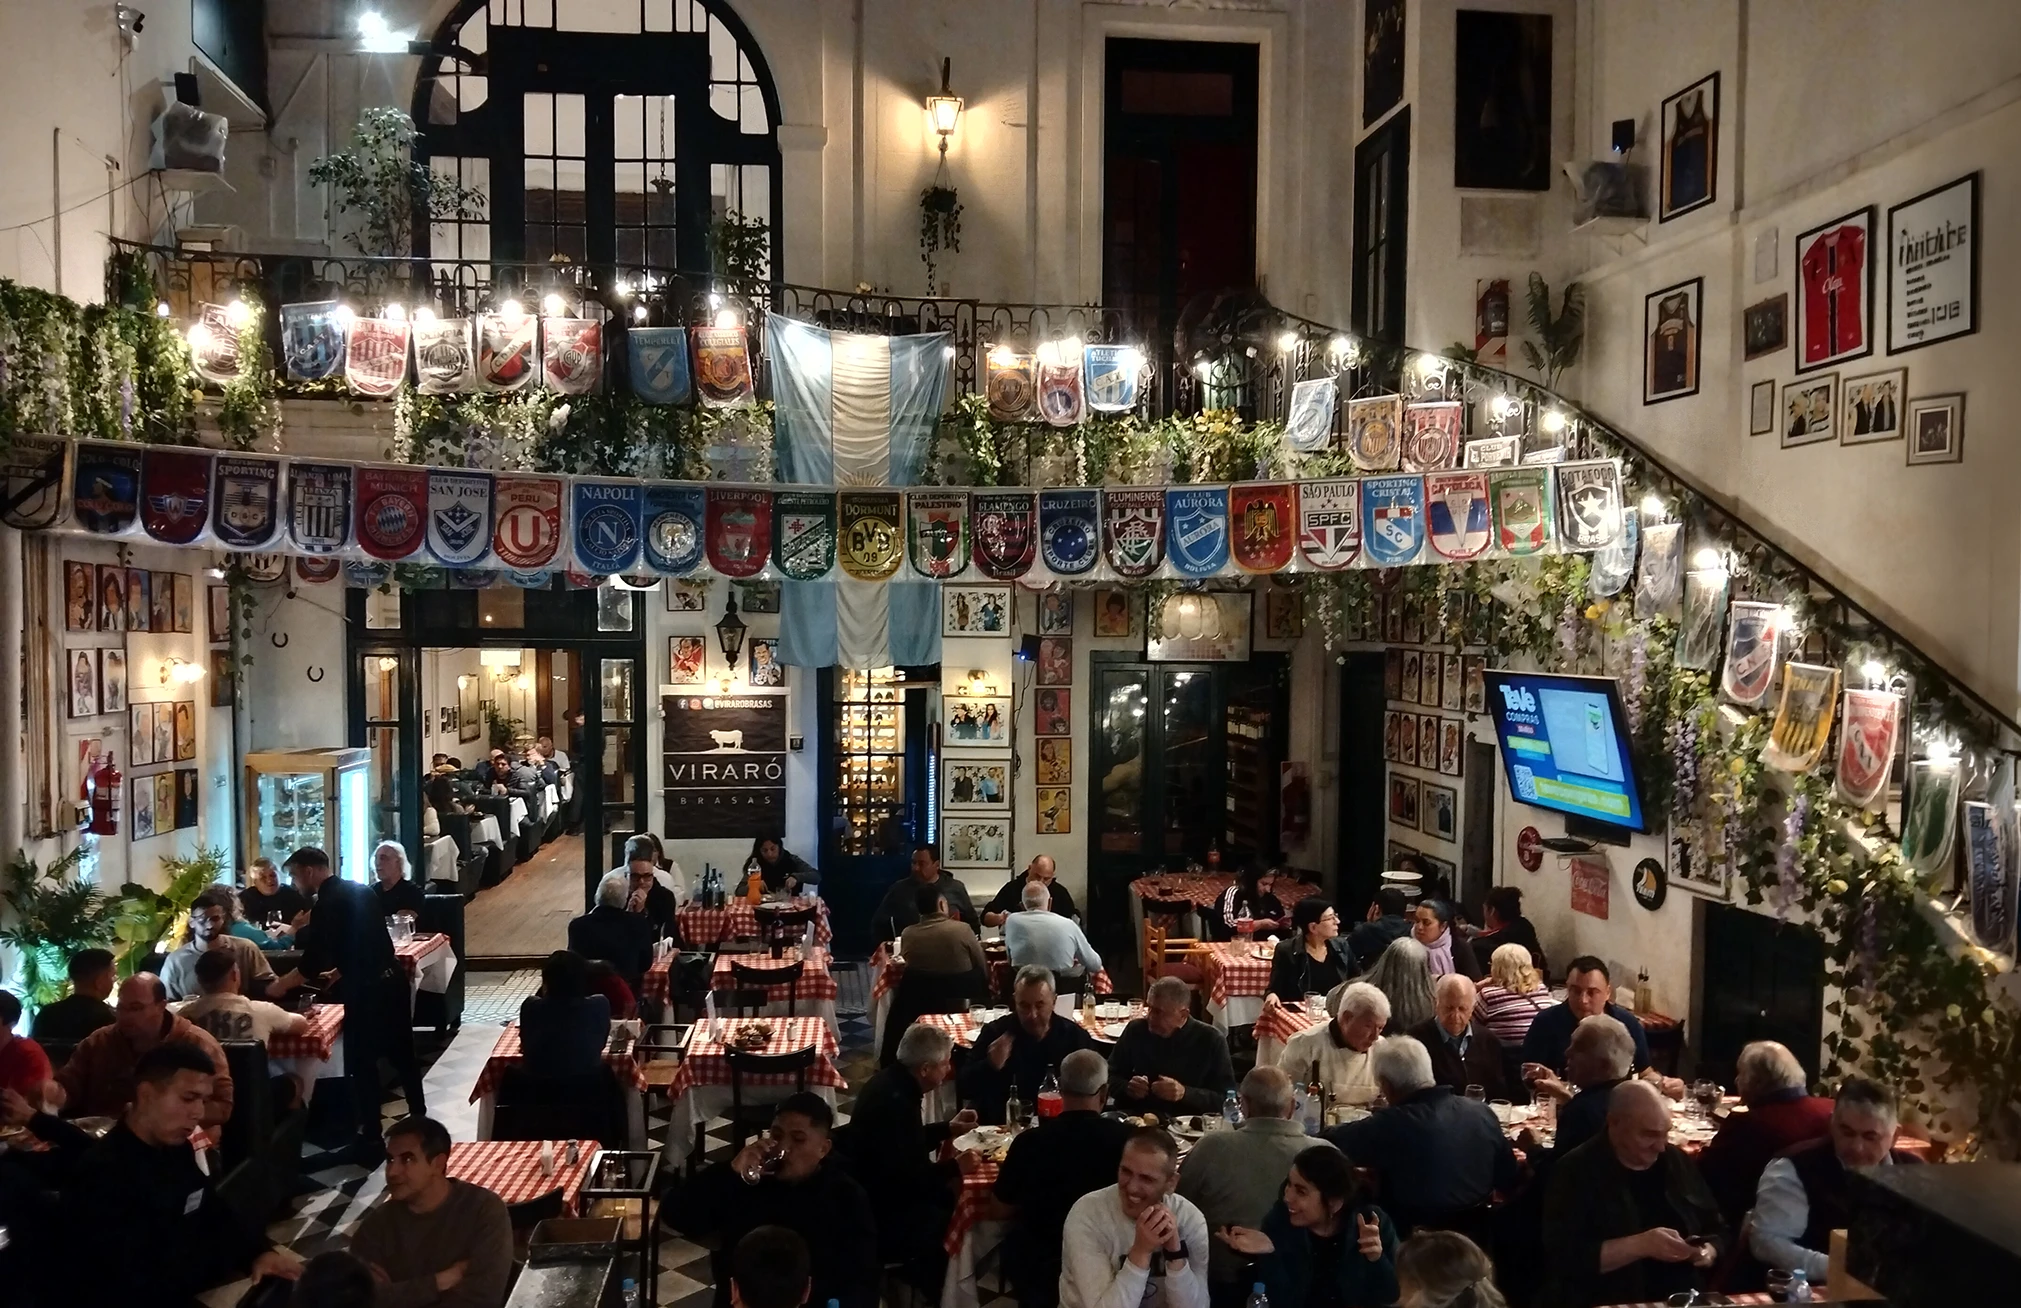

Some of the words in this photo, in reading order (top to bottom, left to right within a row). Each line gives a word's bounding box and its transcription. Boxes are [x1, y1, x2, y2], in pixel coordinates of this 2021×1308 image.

[420, 328, 463, 340] OLIMPIA
[634, 335, 681, 346] TEMPERLEY
[218, 464, 275, 479] SPORTING
[1560, 467, 1615, 486] BOTAFOGO
[370, 482, 418, 493] MUNICH
[1367, 478, 1417, 489] SPORTING
[430, 485, 455, 496] SAN
[458, 486, 488, 498] JOSE
[582, 486, 635, 501] NAPOLI
[710, 490, 768, 504] LIVERPOOL
[1108, 491, 1161, 503] FLUMINENSE
[1324, 484, 1355, 498] PAULO
[1372, 488, 1412, 498] CRISTAL
[511, 494, 540, 503] PERU
[915, 501, 962, 509] PALESTINO
[1041, 499, 1096, 510] CRUZEIRO
[1175, 497, 1224, 509] AURORA
[845, 504, 898, 516] DORMUNT
[1308, 513, 1351, 527] SPFC
[596, 521, 618, 545] N
[1048, 519, 1091, 535] CRUZEIRO
[1182, 521, 1220, 546] AURORA
[511, 515, 540, 553] U
[592, 561, 621, 571] ITALIA
[1499, 684, 1536, 713] Tele
[1506, 711, 1540, 725] COMPRAS
[669, 757, 782, 781] VIRARÓ
[680, 796, 771, 805] BRASAS
